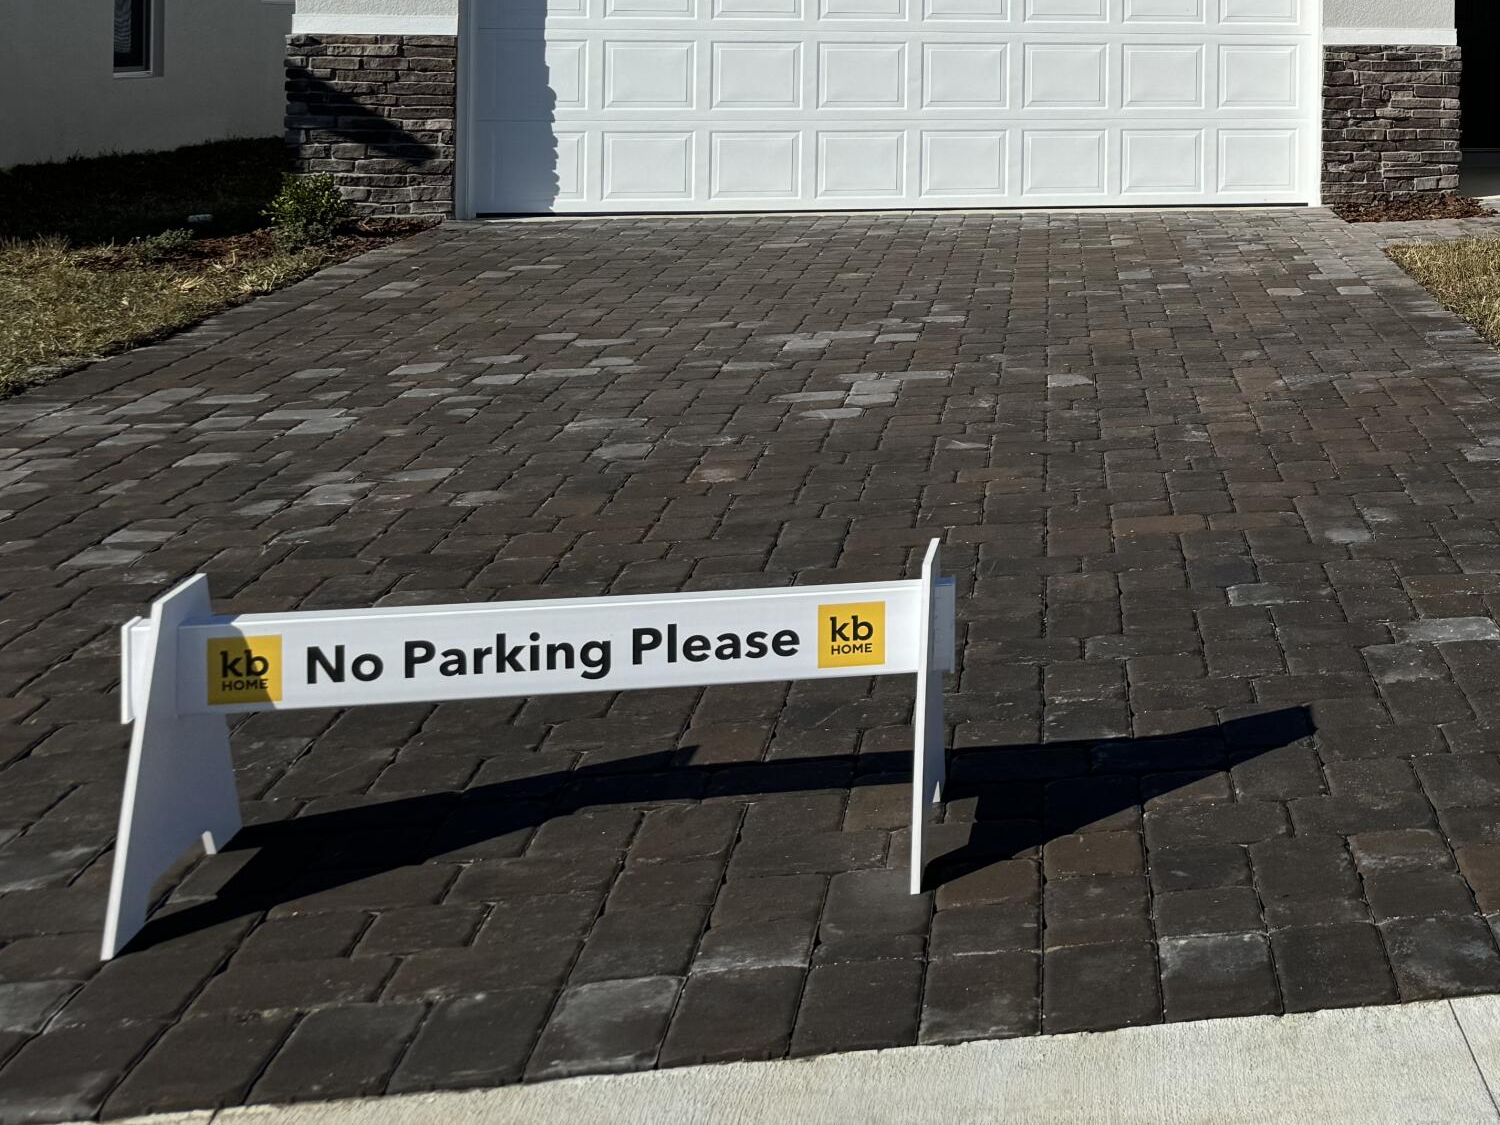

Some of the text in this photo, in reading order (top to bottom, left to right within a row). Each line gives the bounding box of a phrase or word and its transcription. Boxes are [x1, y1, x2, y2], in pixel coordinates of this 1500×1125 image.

[829, 614, 874, 643] kb
[306, 623, 800, 685] No Parking Please
[830, 642, 873, 655] HOME
[220, 649, 270, 678] kb
[221, 678, 269, 692] HOME
